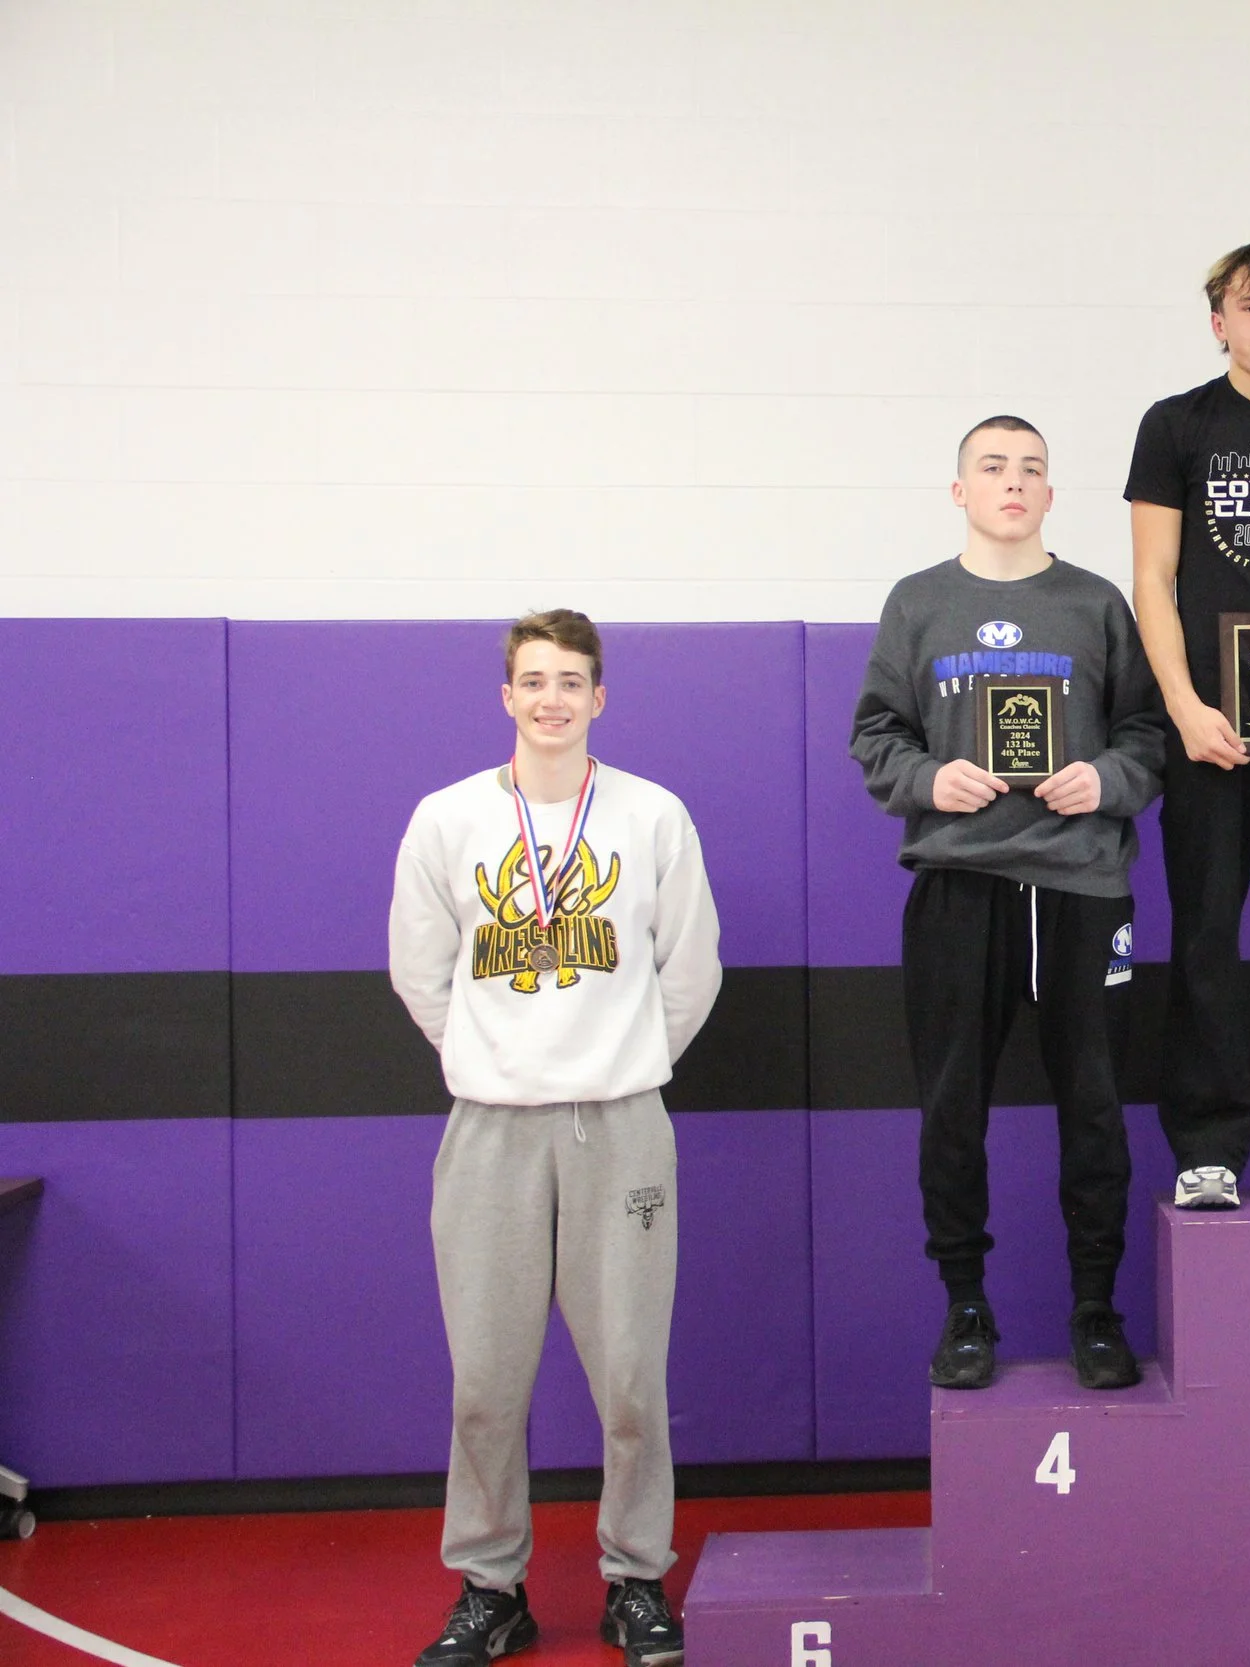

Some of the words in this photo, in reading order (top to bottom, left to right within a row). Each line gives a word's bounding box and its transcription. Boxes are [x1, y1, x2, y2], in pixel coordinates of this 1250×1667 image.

[1204, 500, 1250, 567] SOUTHWEST
[981, 624, 1019, 646] M
[1006, 740, 1020, 748] 132
[1022, 740, 1035, 748] lbs
[1010, 732, 1031, 740] 2024
[1035, 1432, 1076, 1495] 4
[791, 1621, 832, 1667] 6
